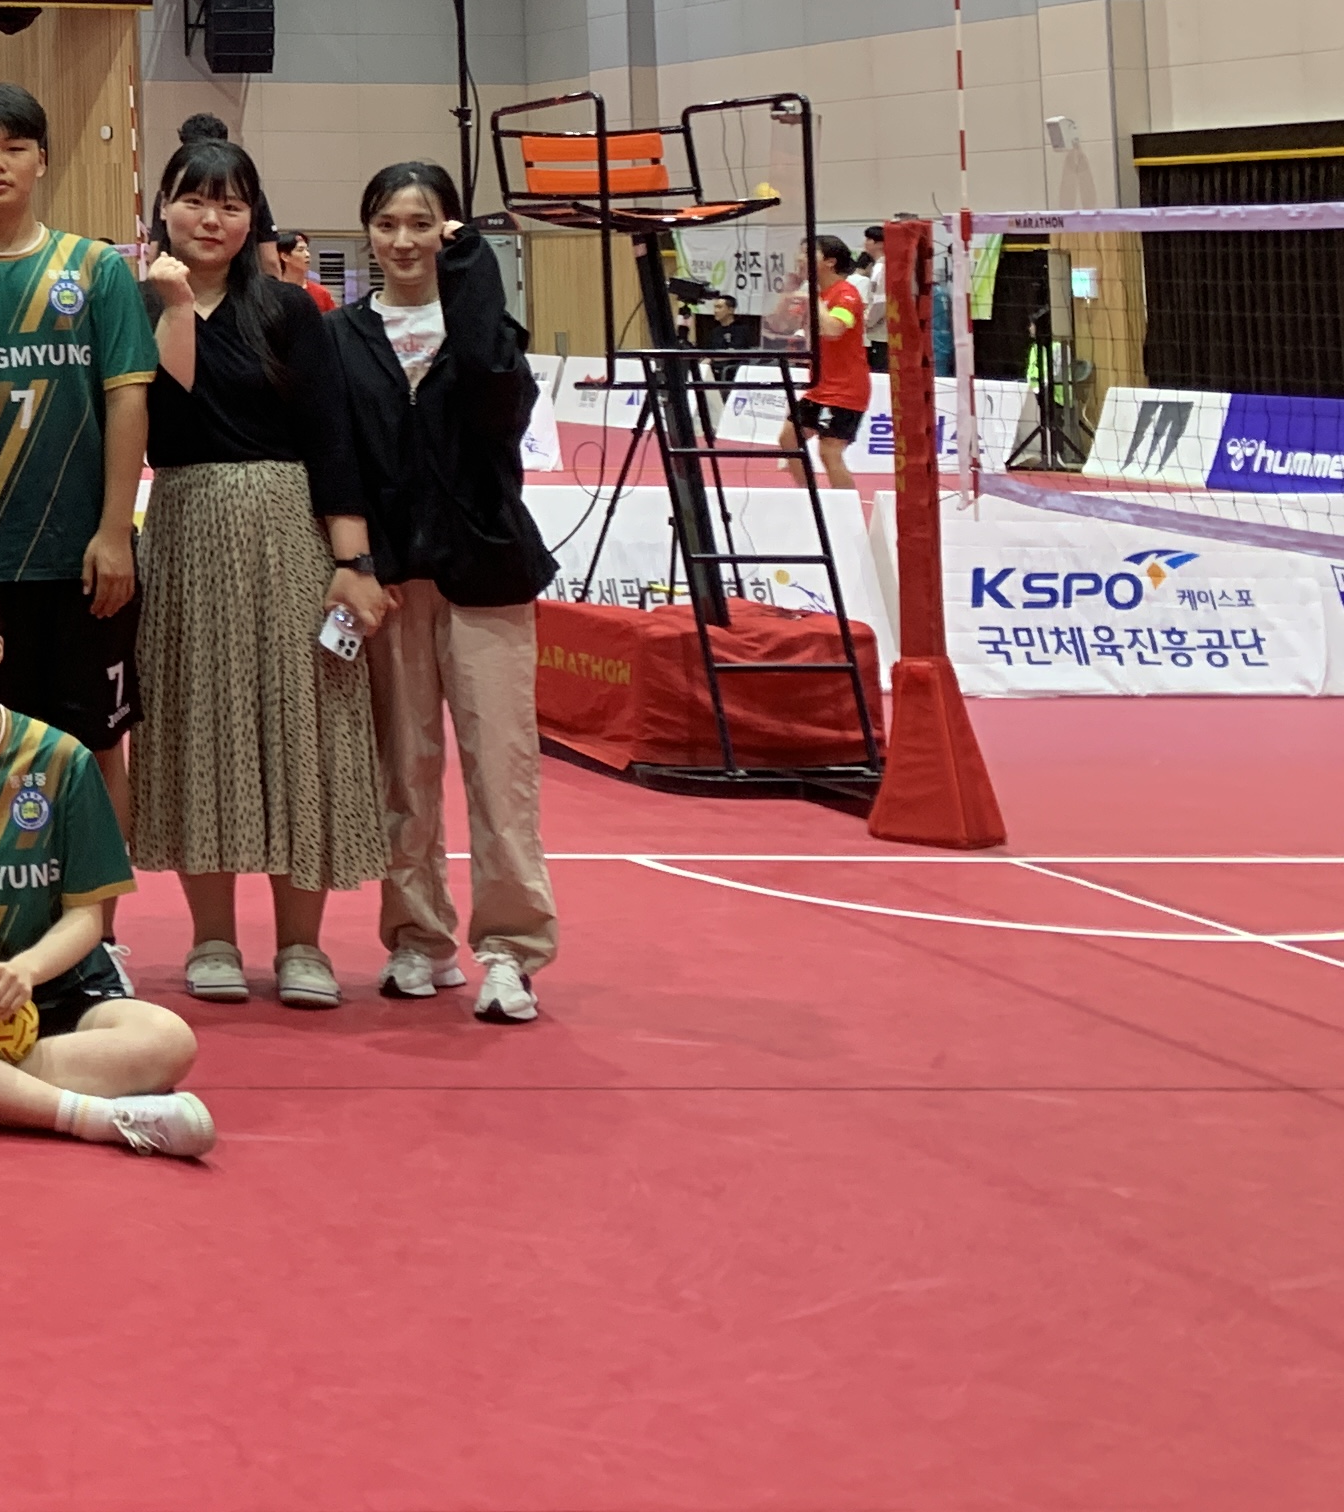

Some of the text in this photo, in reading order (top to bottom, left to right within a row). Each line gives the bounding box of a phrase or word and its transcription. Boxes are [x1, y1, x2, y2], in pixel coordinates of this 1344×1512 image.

[1015, 216, 1064, 229] MARATHON
[734, 251, 762, 290] 청주
[10, 389, 35, 429] 7
[971, 567, 1256, 611] KSPO 케이스포
[538, 646, 632, 686] ARATHON
[978, 626, 1269, 668] 국민체육진흥공단
[106, 661, 124, 708] 7
